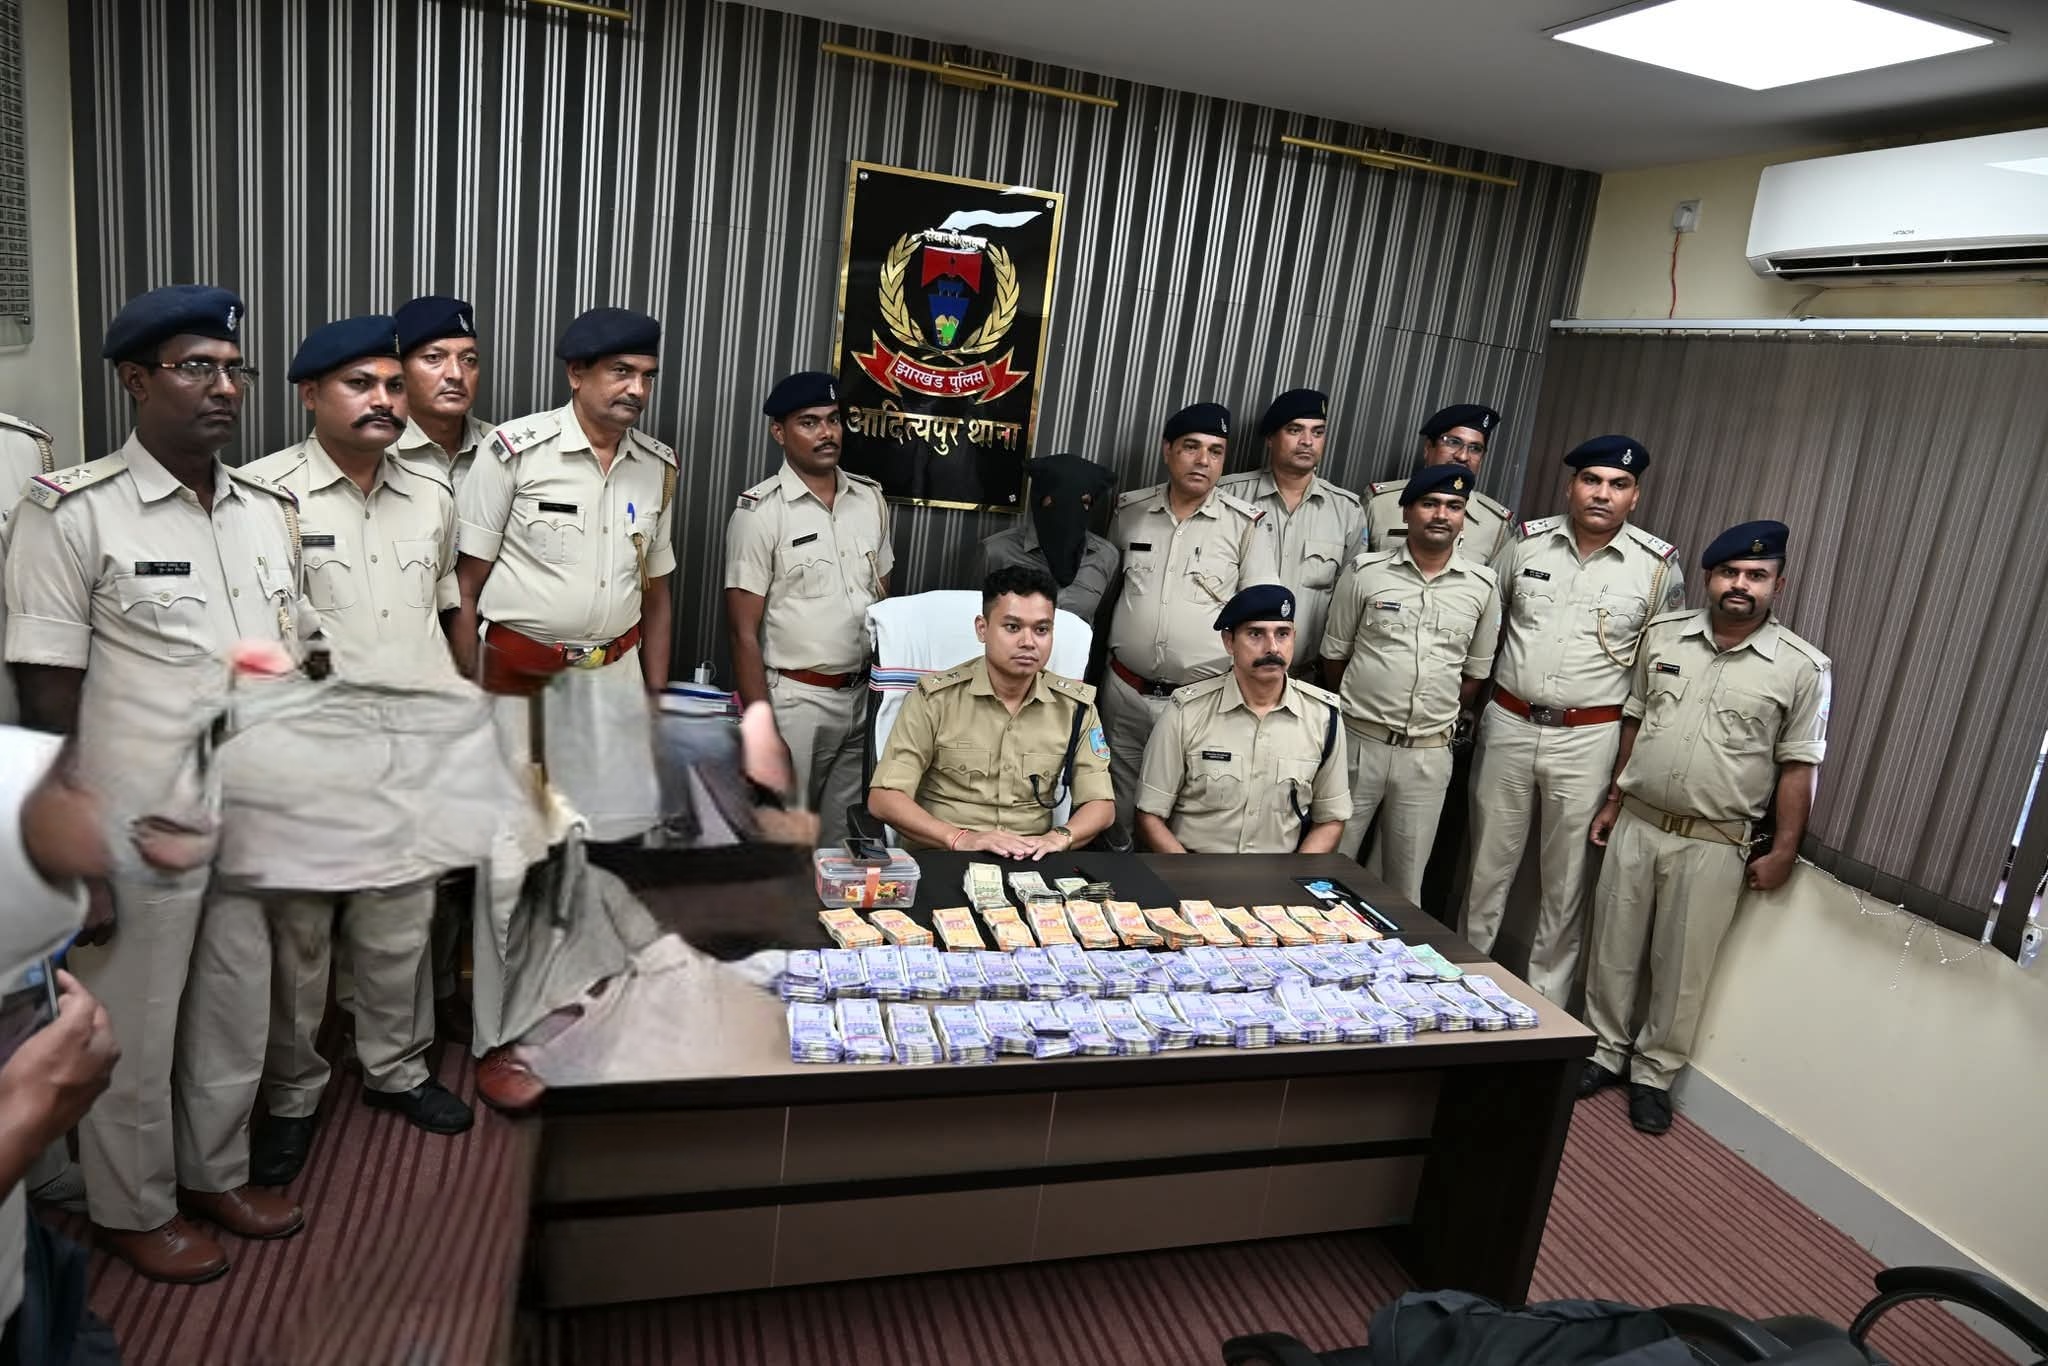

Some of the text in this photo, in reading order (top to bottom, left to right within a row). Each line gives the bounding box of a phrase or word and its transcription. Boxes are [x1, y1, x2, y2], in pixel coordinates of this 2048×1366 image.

[895, 360, 984, 393] झारखंड पुलिस
[846, 399, 1022, 455] आदित्यपुर थाना
